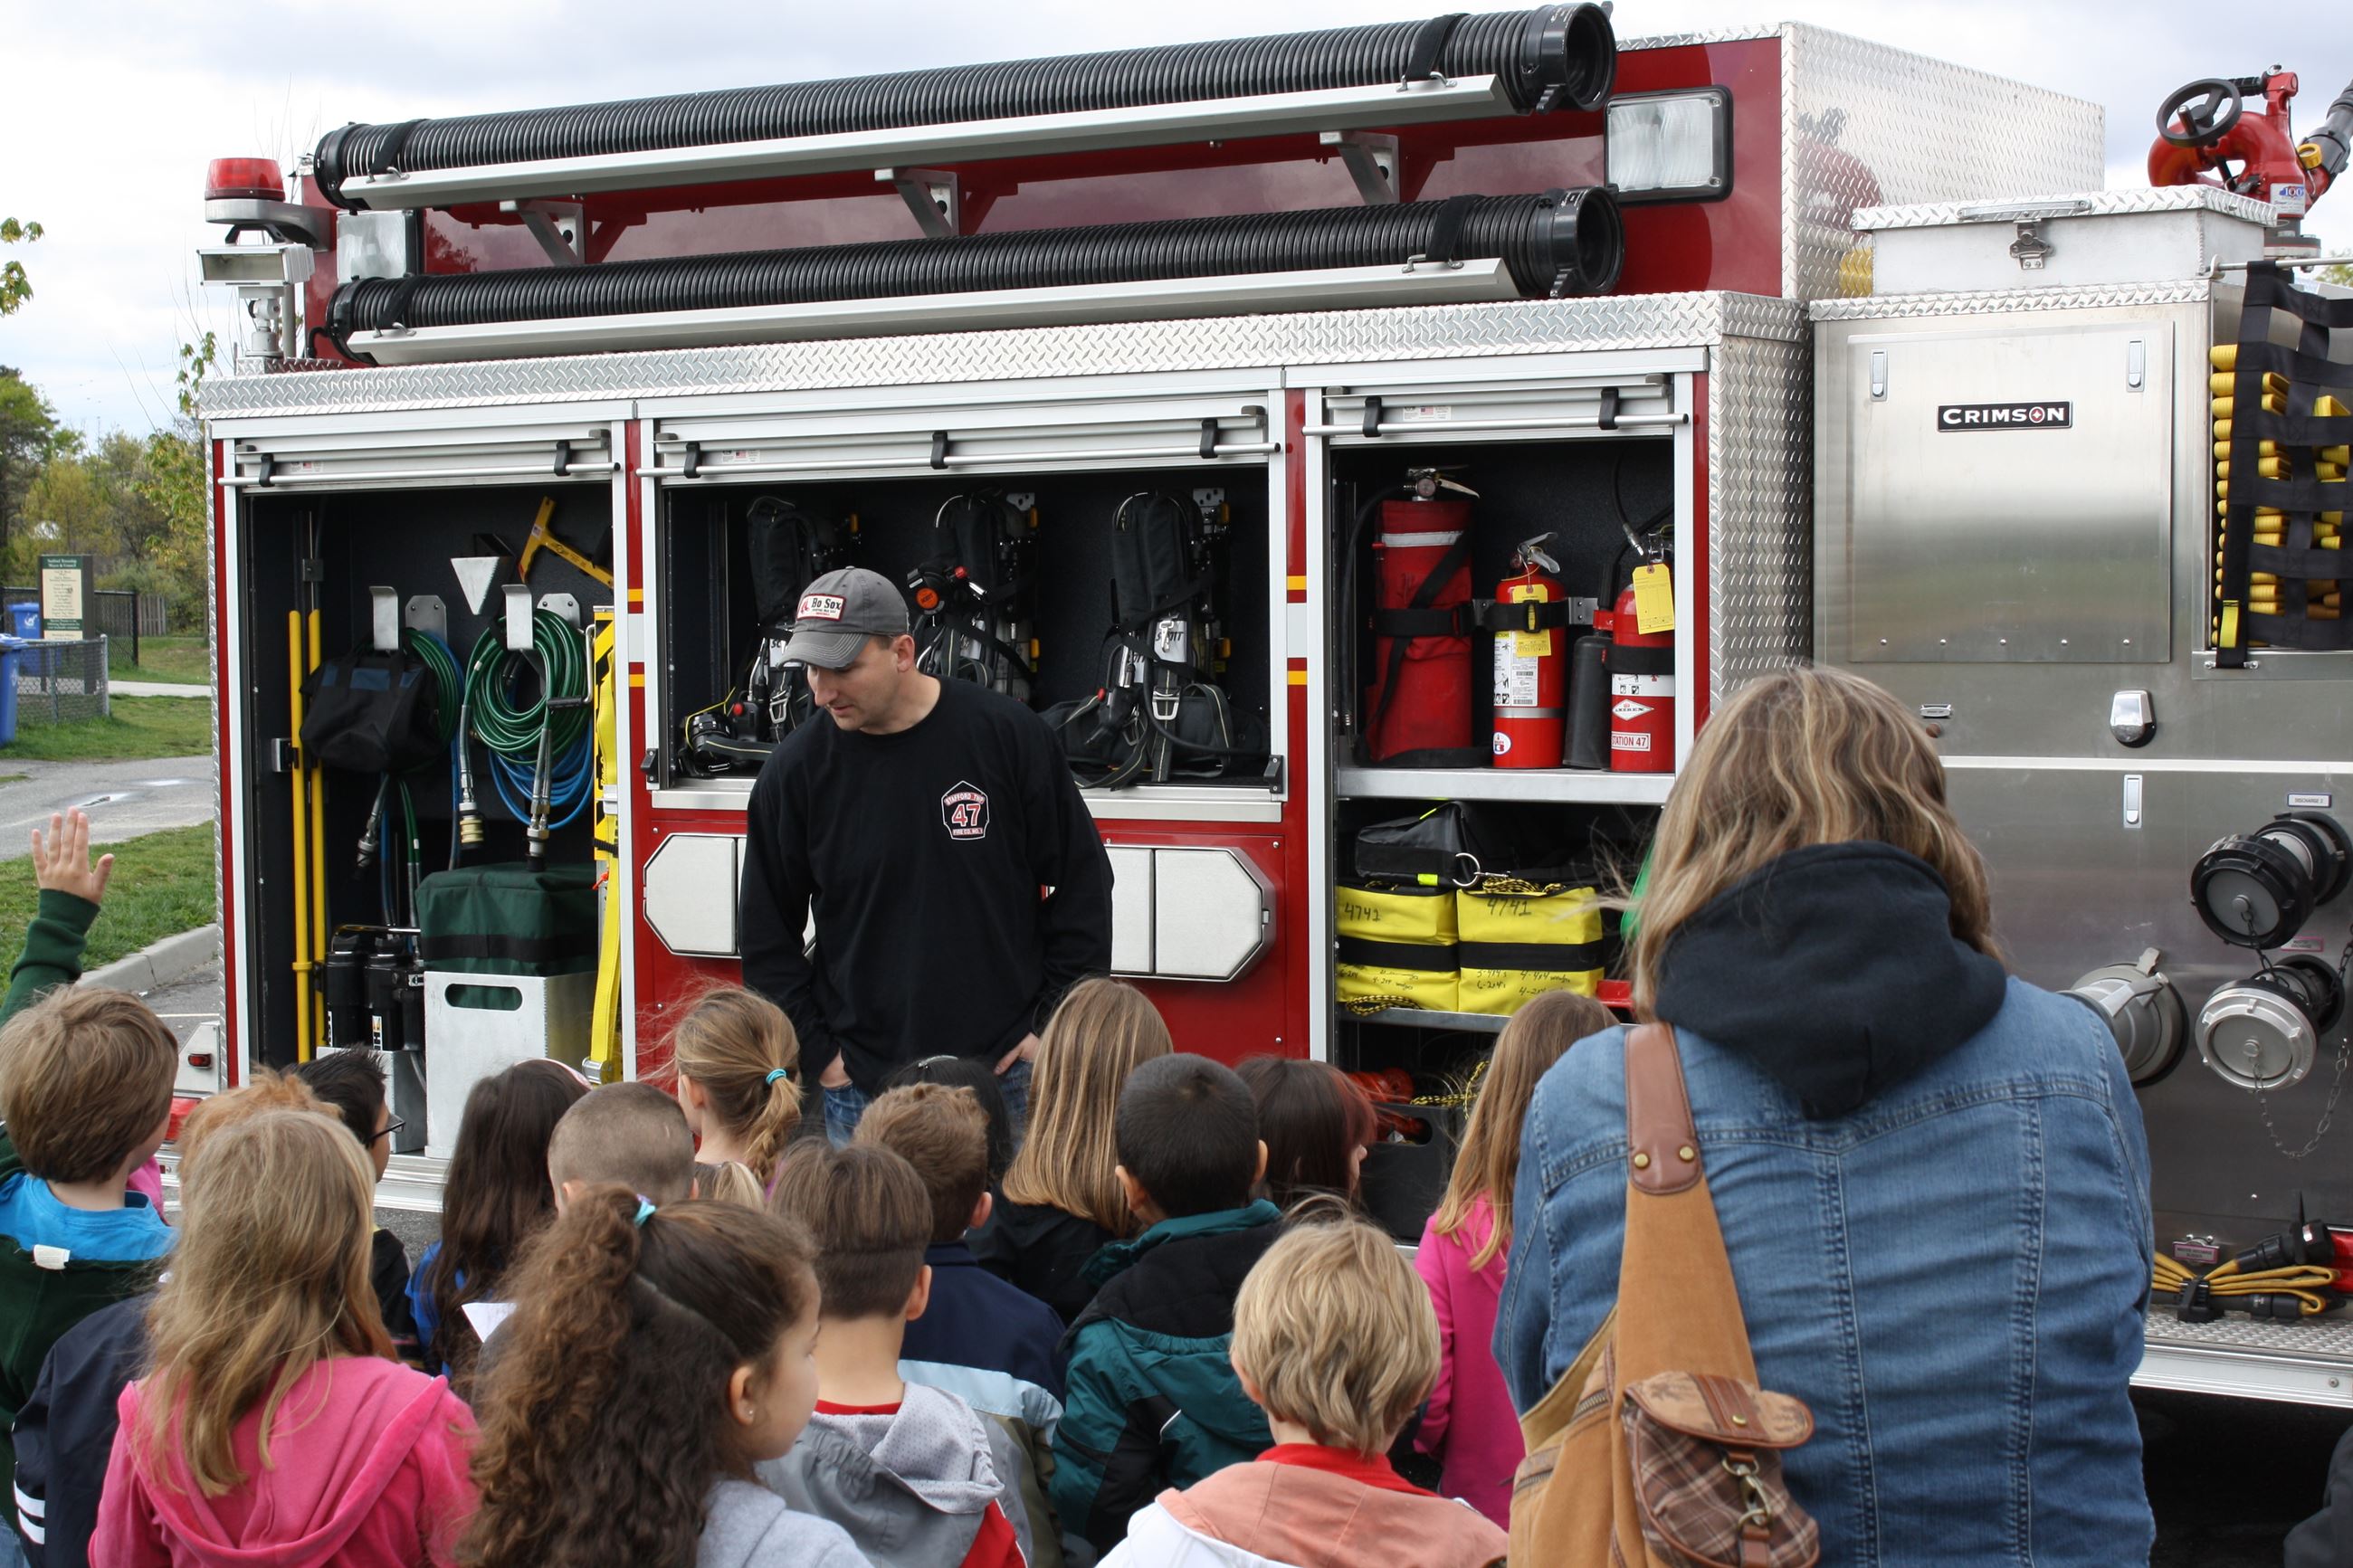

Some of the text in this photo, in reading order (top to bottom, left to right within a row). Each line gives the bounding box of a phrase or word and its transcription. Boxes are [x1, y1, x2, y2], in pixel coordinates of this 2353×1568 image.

[1943, 406, 2064, 424] CRIMSON
[812, 598, 841, 610] Bo Sox
[1636, 737, 1646, 746] 47
[944, 792, 972, 806] STAFFORD
[952, 803, 980, 827] 47
[1487, 898, 1531, 917] 4741
